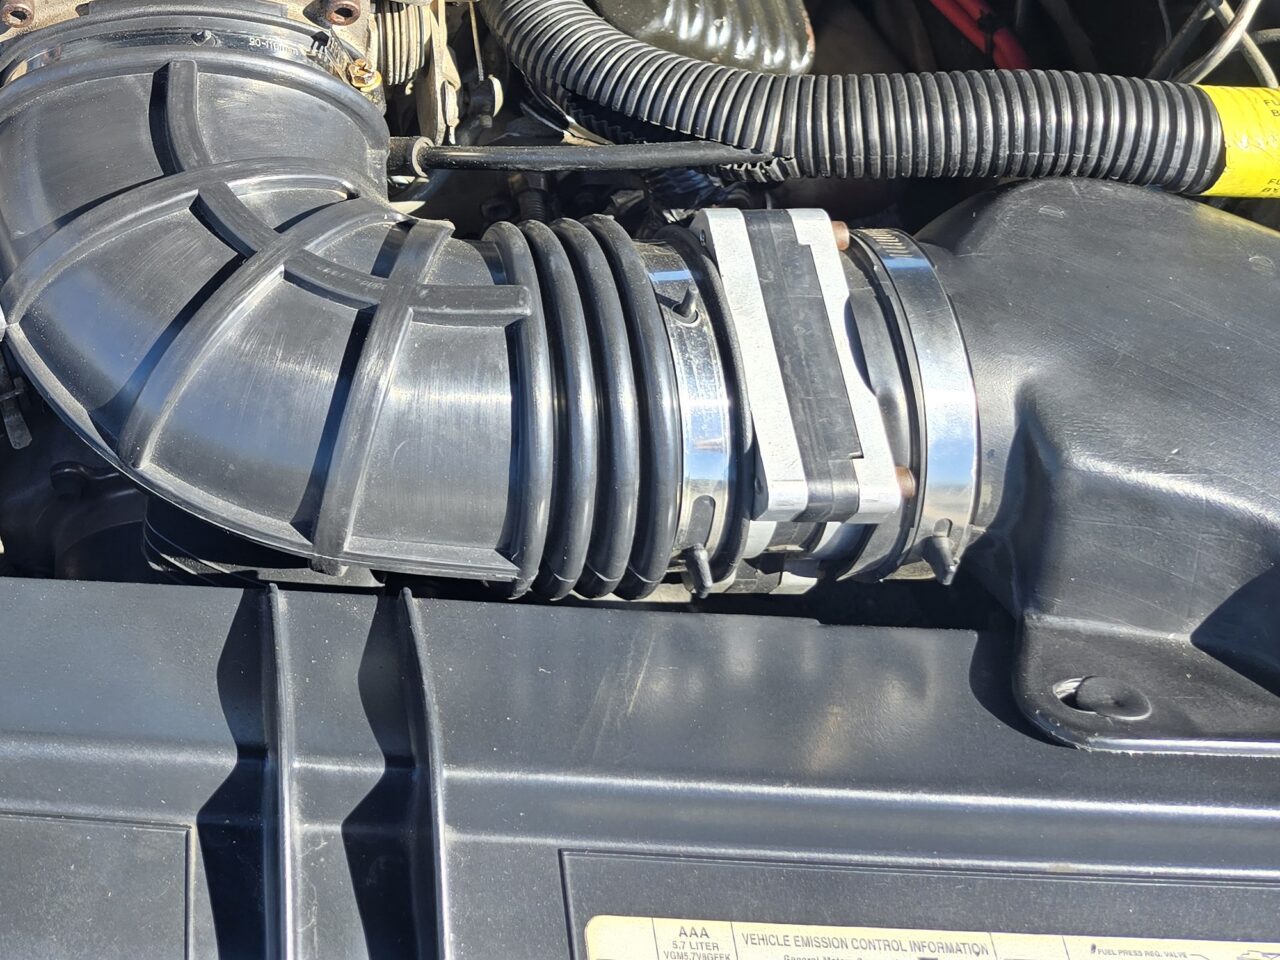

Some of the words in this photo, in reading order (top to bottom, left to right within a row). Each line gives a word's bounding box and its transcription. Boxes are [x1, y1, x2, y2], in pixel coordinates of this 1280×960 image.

[679, 926, 710, 939] AAA
[672, 941, 686, 949] 5.7
[689, 942, 720, 951] LITER
[741, 933, 790, 947] VEHICLE
[794, 936, 848, 950] EMISSION
[851, 938, 907, 952] CONTROL
[910, 940, 989, 956] INFORMATION
